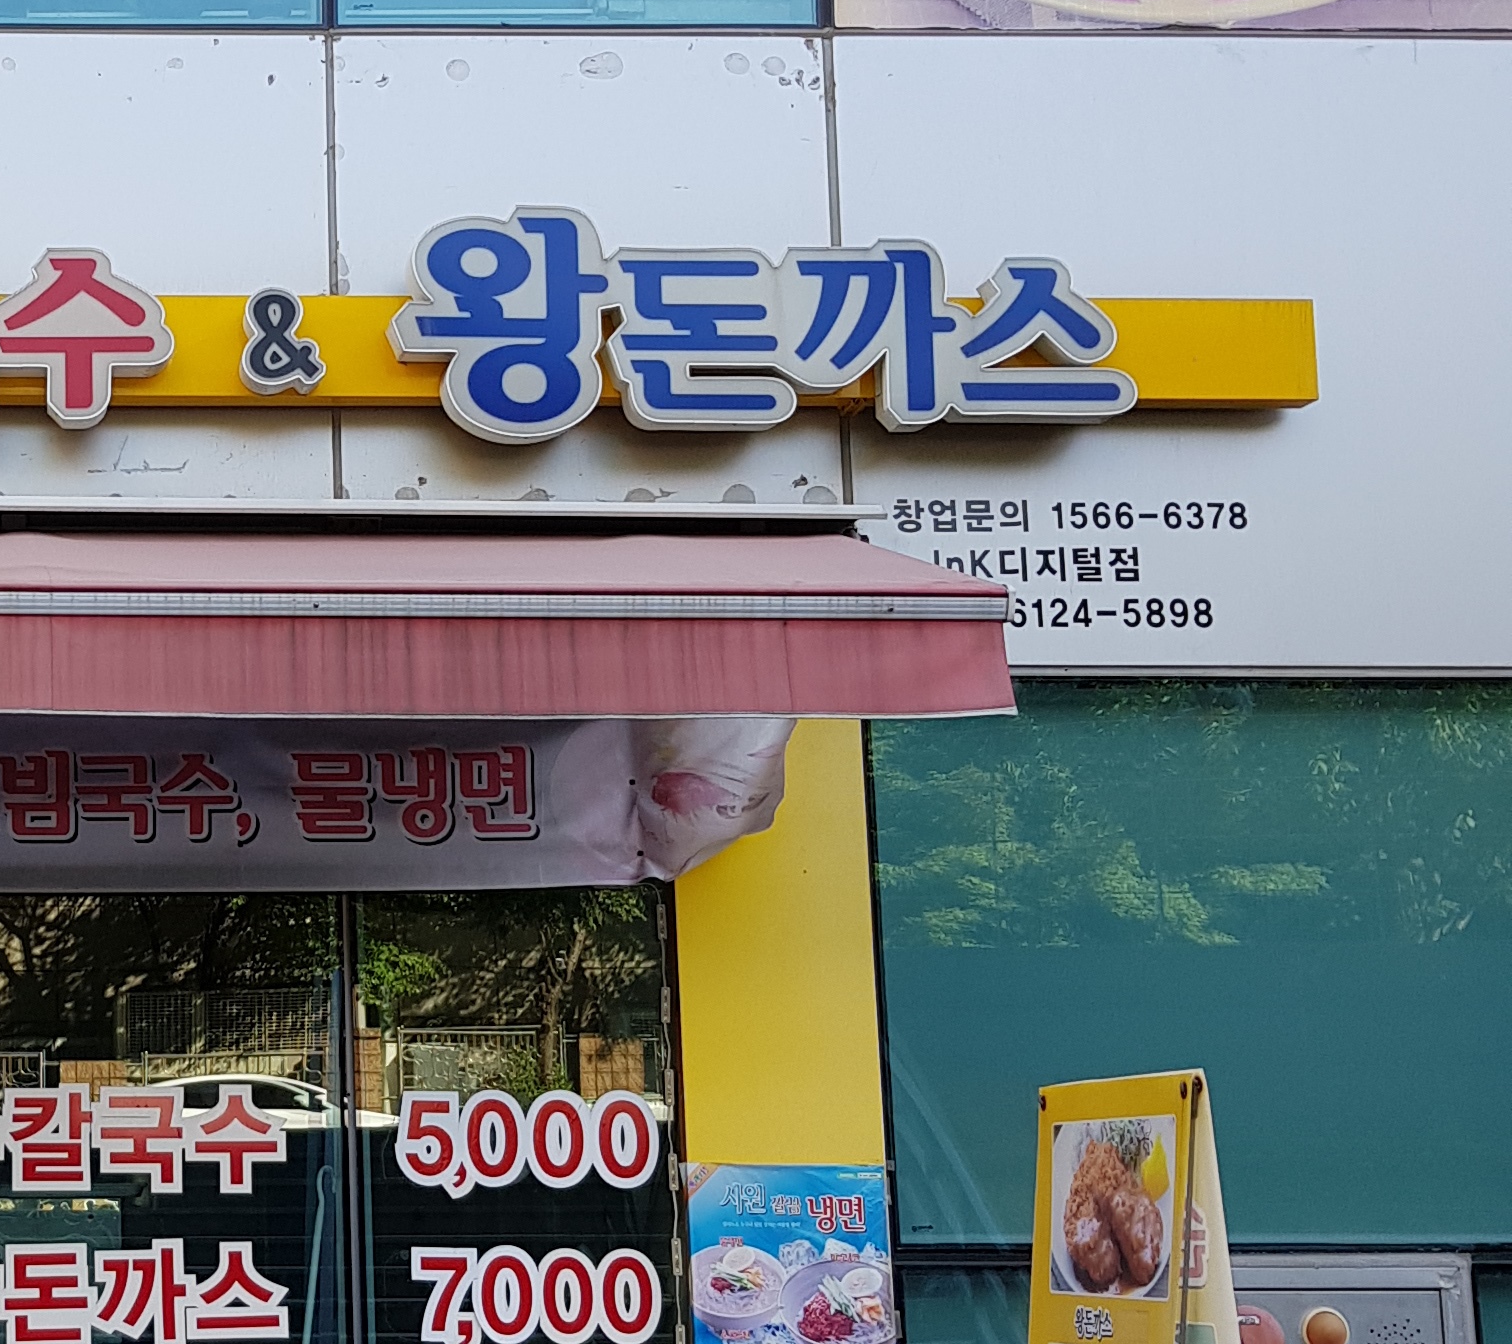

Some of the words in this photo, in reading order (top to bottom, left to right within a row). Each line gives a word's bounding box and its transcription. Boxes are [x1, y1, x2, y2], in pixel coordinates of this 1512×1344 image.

[240, 287, 326, 395] &
[392, 207, 1136, 438] 왕돈까스
[892, 499, 1030, 533] 창업문의
[1052, 502, 1249, 530] 1566-6378
[289, 744, 538, 842] 물냉면
[395, 1089, 660, 1200] 5,000
[720, 1182, 768, 1216] 시원
[806, 1194, 868, 1234] 냉면
[1074, 1306, 1113, 1339] 왕돈까스
